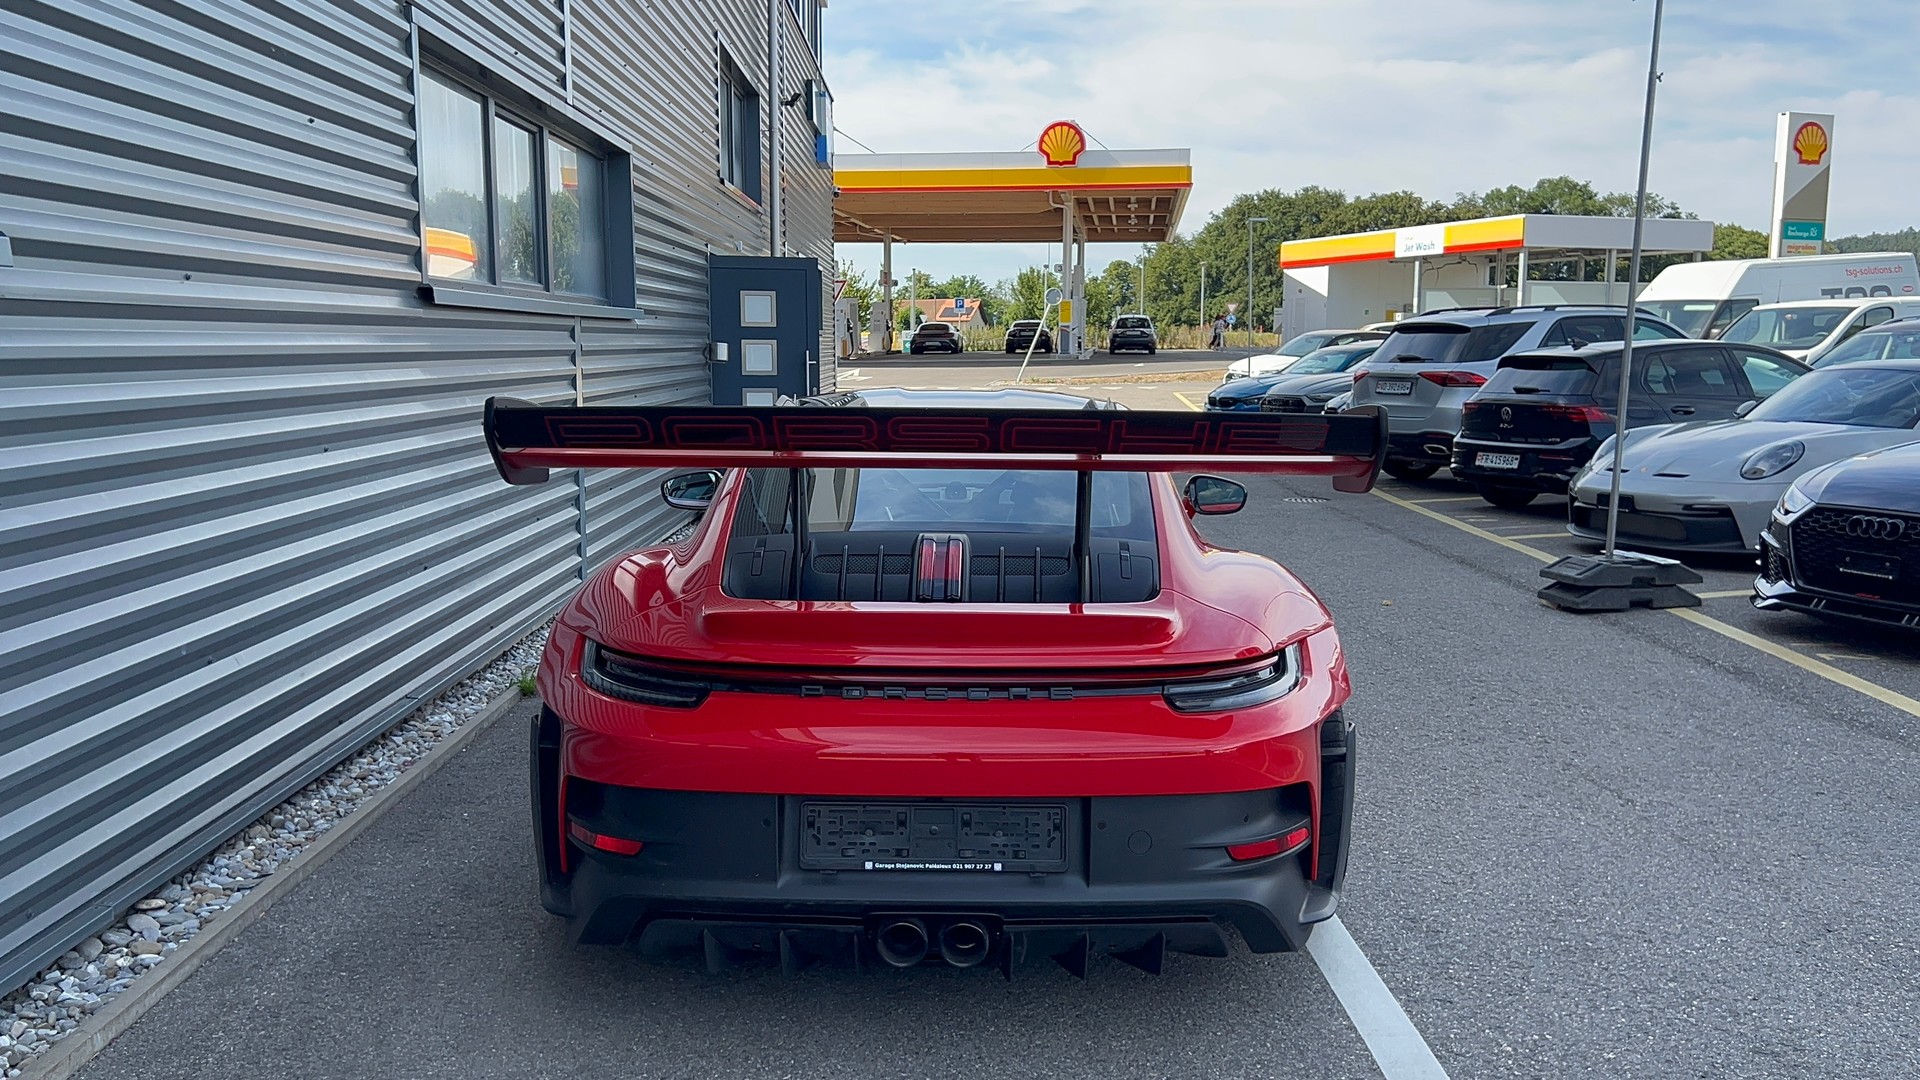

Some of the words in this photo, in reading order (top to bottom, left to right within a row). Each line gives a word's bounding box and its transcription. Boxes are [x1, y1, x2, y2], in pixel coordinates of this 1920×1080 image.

[1845, 264, 1903, 278] tsg-solutions.ch
[544, 416, 1330, 454] PORSCHE
[801, 685, 1073, 700] PORSCHE
[875, 862, 895, 870] Garage
